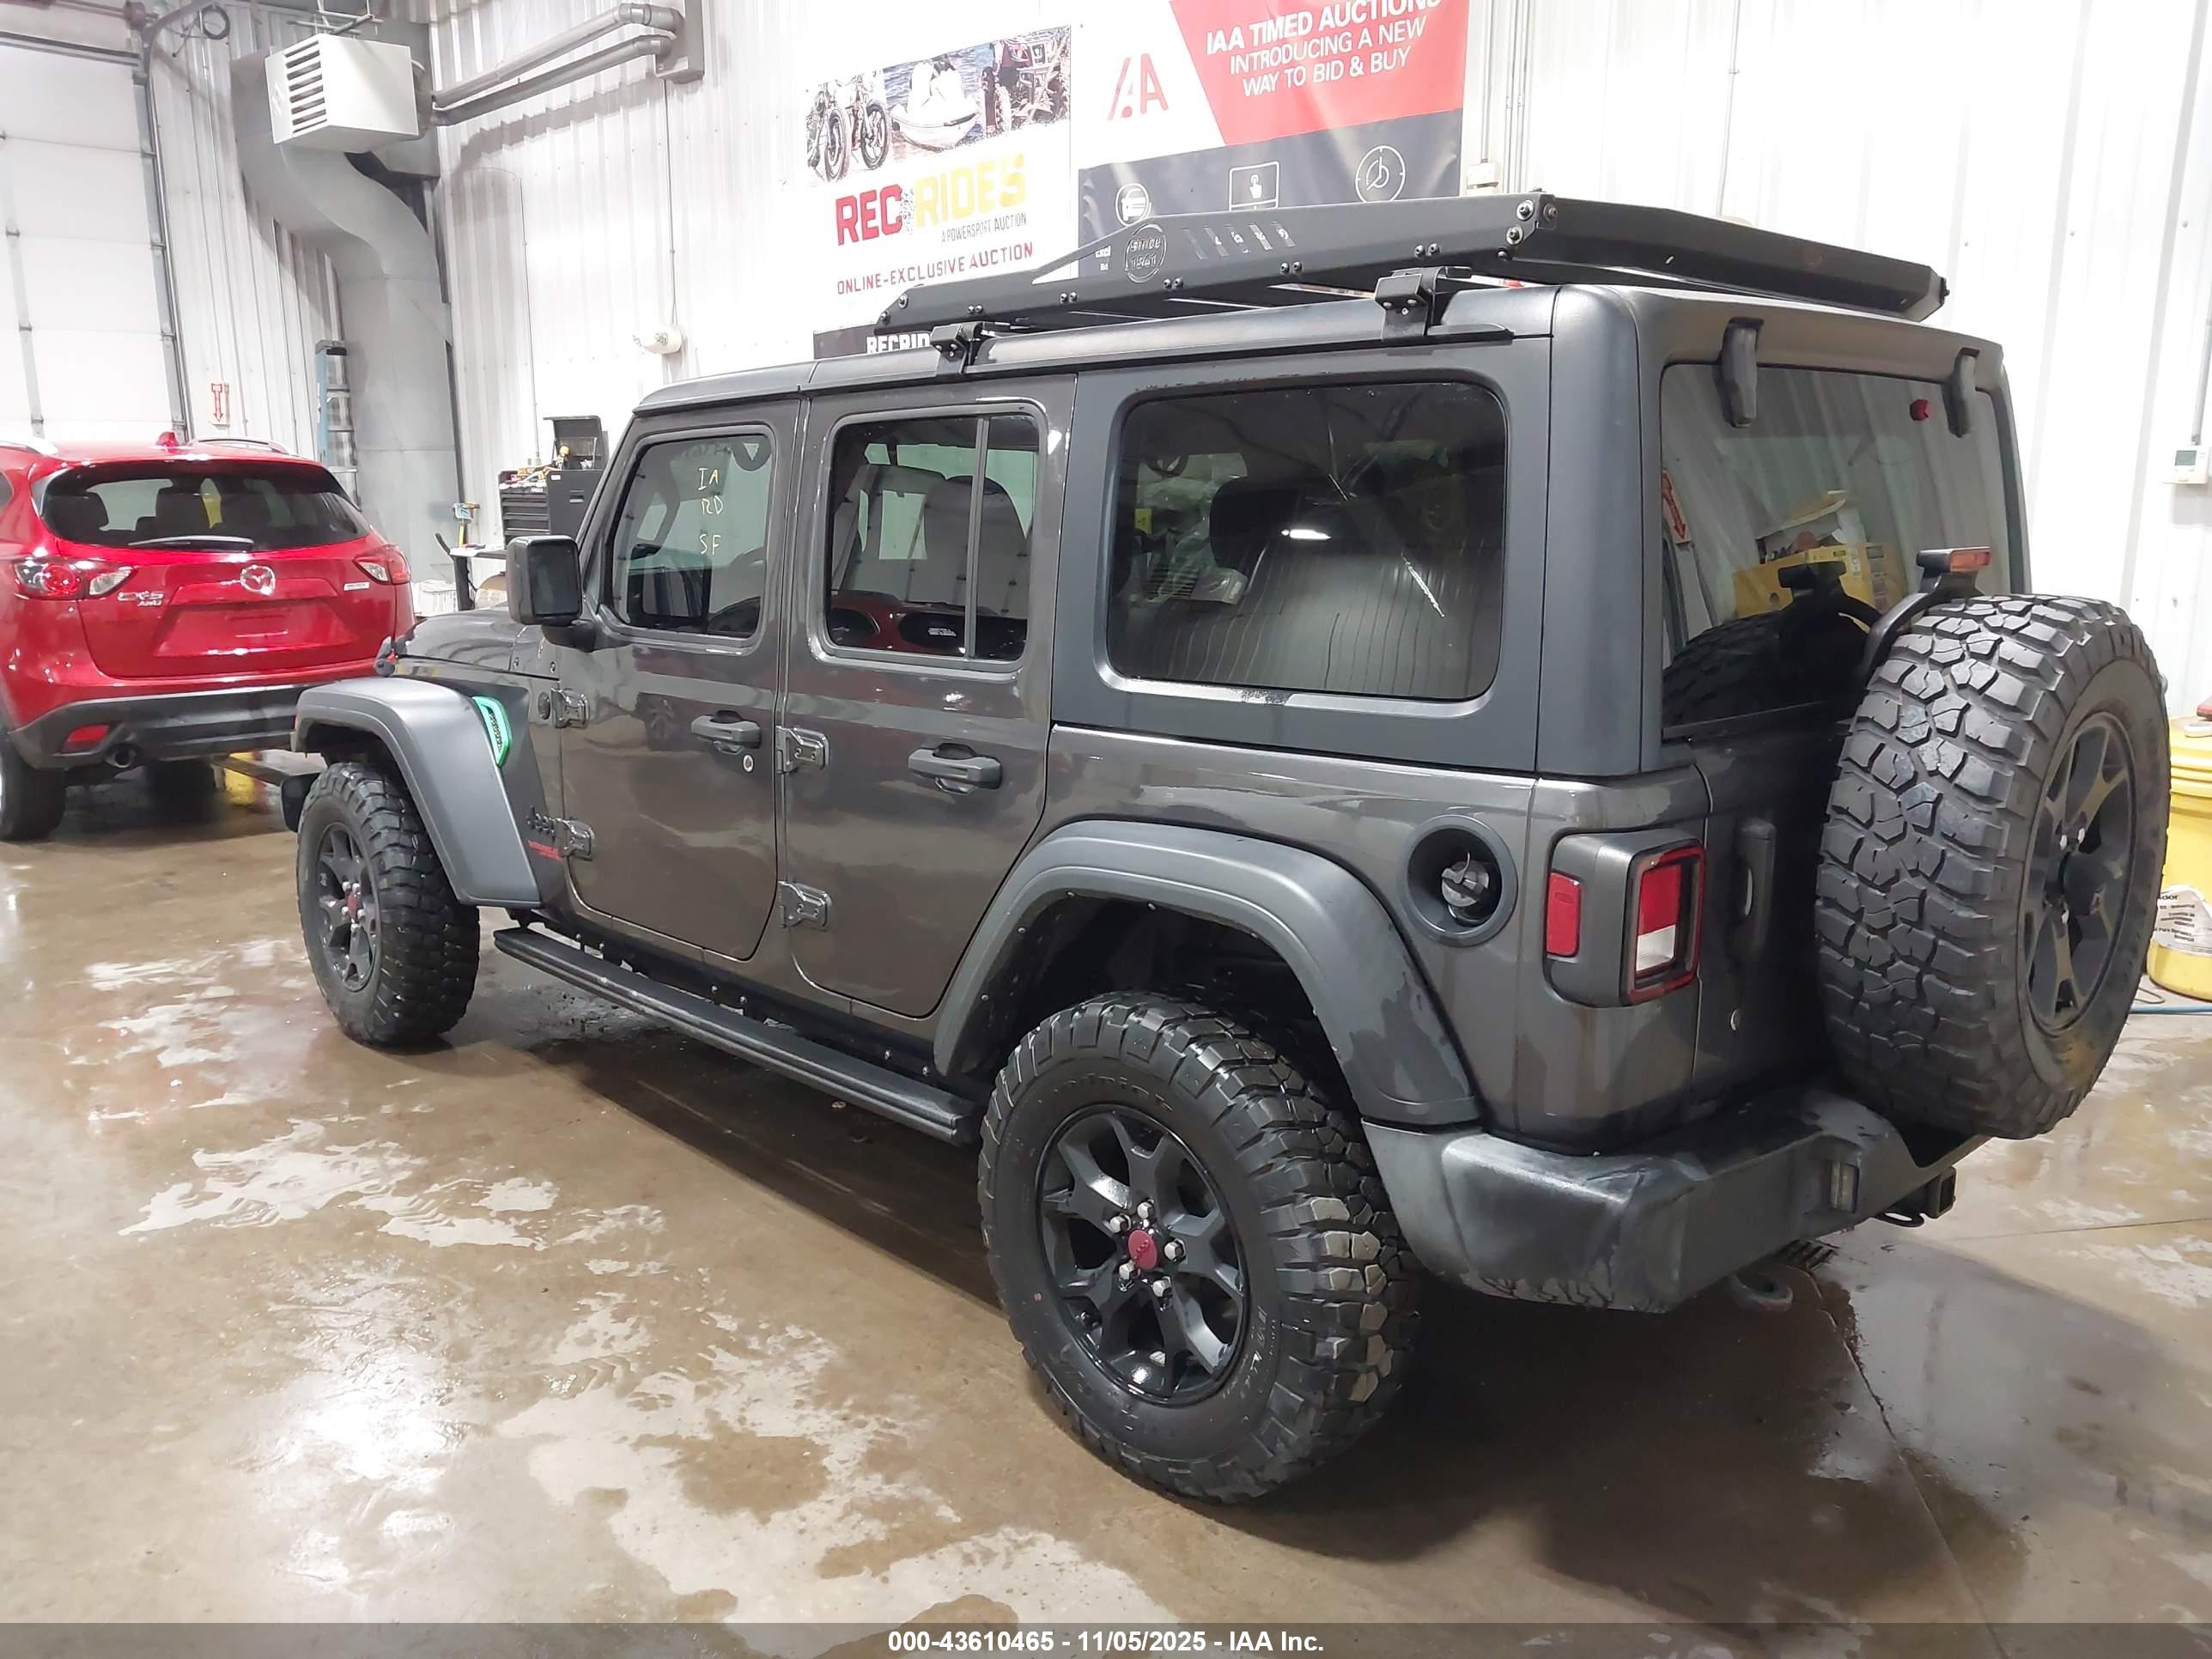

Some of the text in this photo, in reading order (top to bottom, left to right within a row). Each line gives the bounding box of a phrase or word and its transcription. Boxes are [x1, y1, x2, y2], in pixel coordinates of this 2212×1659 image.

[1206, 27, 1245, 55] IAA
[1249, 10, 1313, 46] TIMED
[1230, 15, 1427, 75] INTRODUCING A NEW
[1243, 46, 1412, 96] WAY TO BID & BUY
[947, 219, 991, 241] POWERSPORT
[994, 212, 1027, 234] AUCTION
[837, 242, 1034, 295] ONLINE-EXCLUSIVE AUCTION
[697, 467, 720, 490] IA
[699, 533, 722, 556] SF
